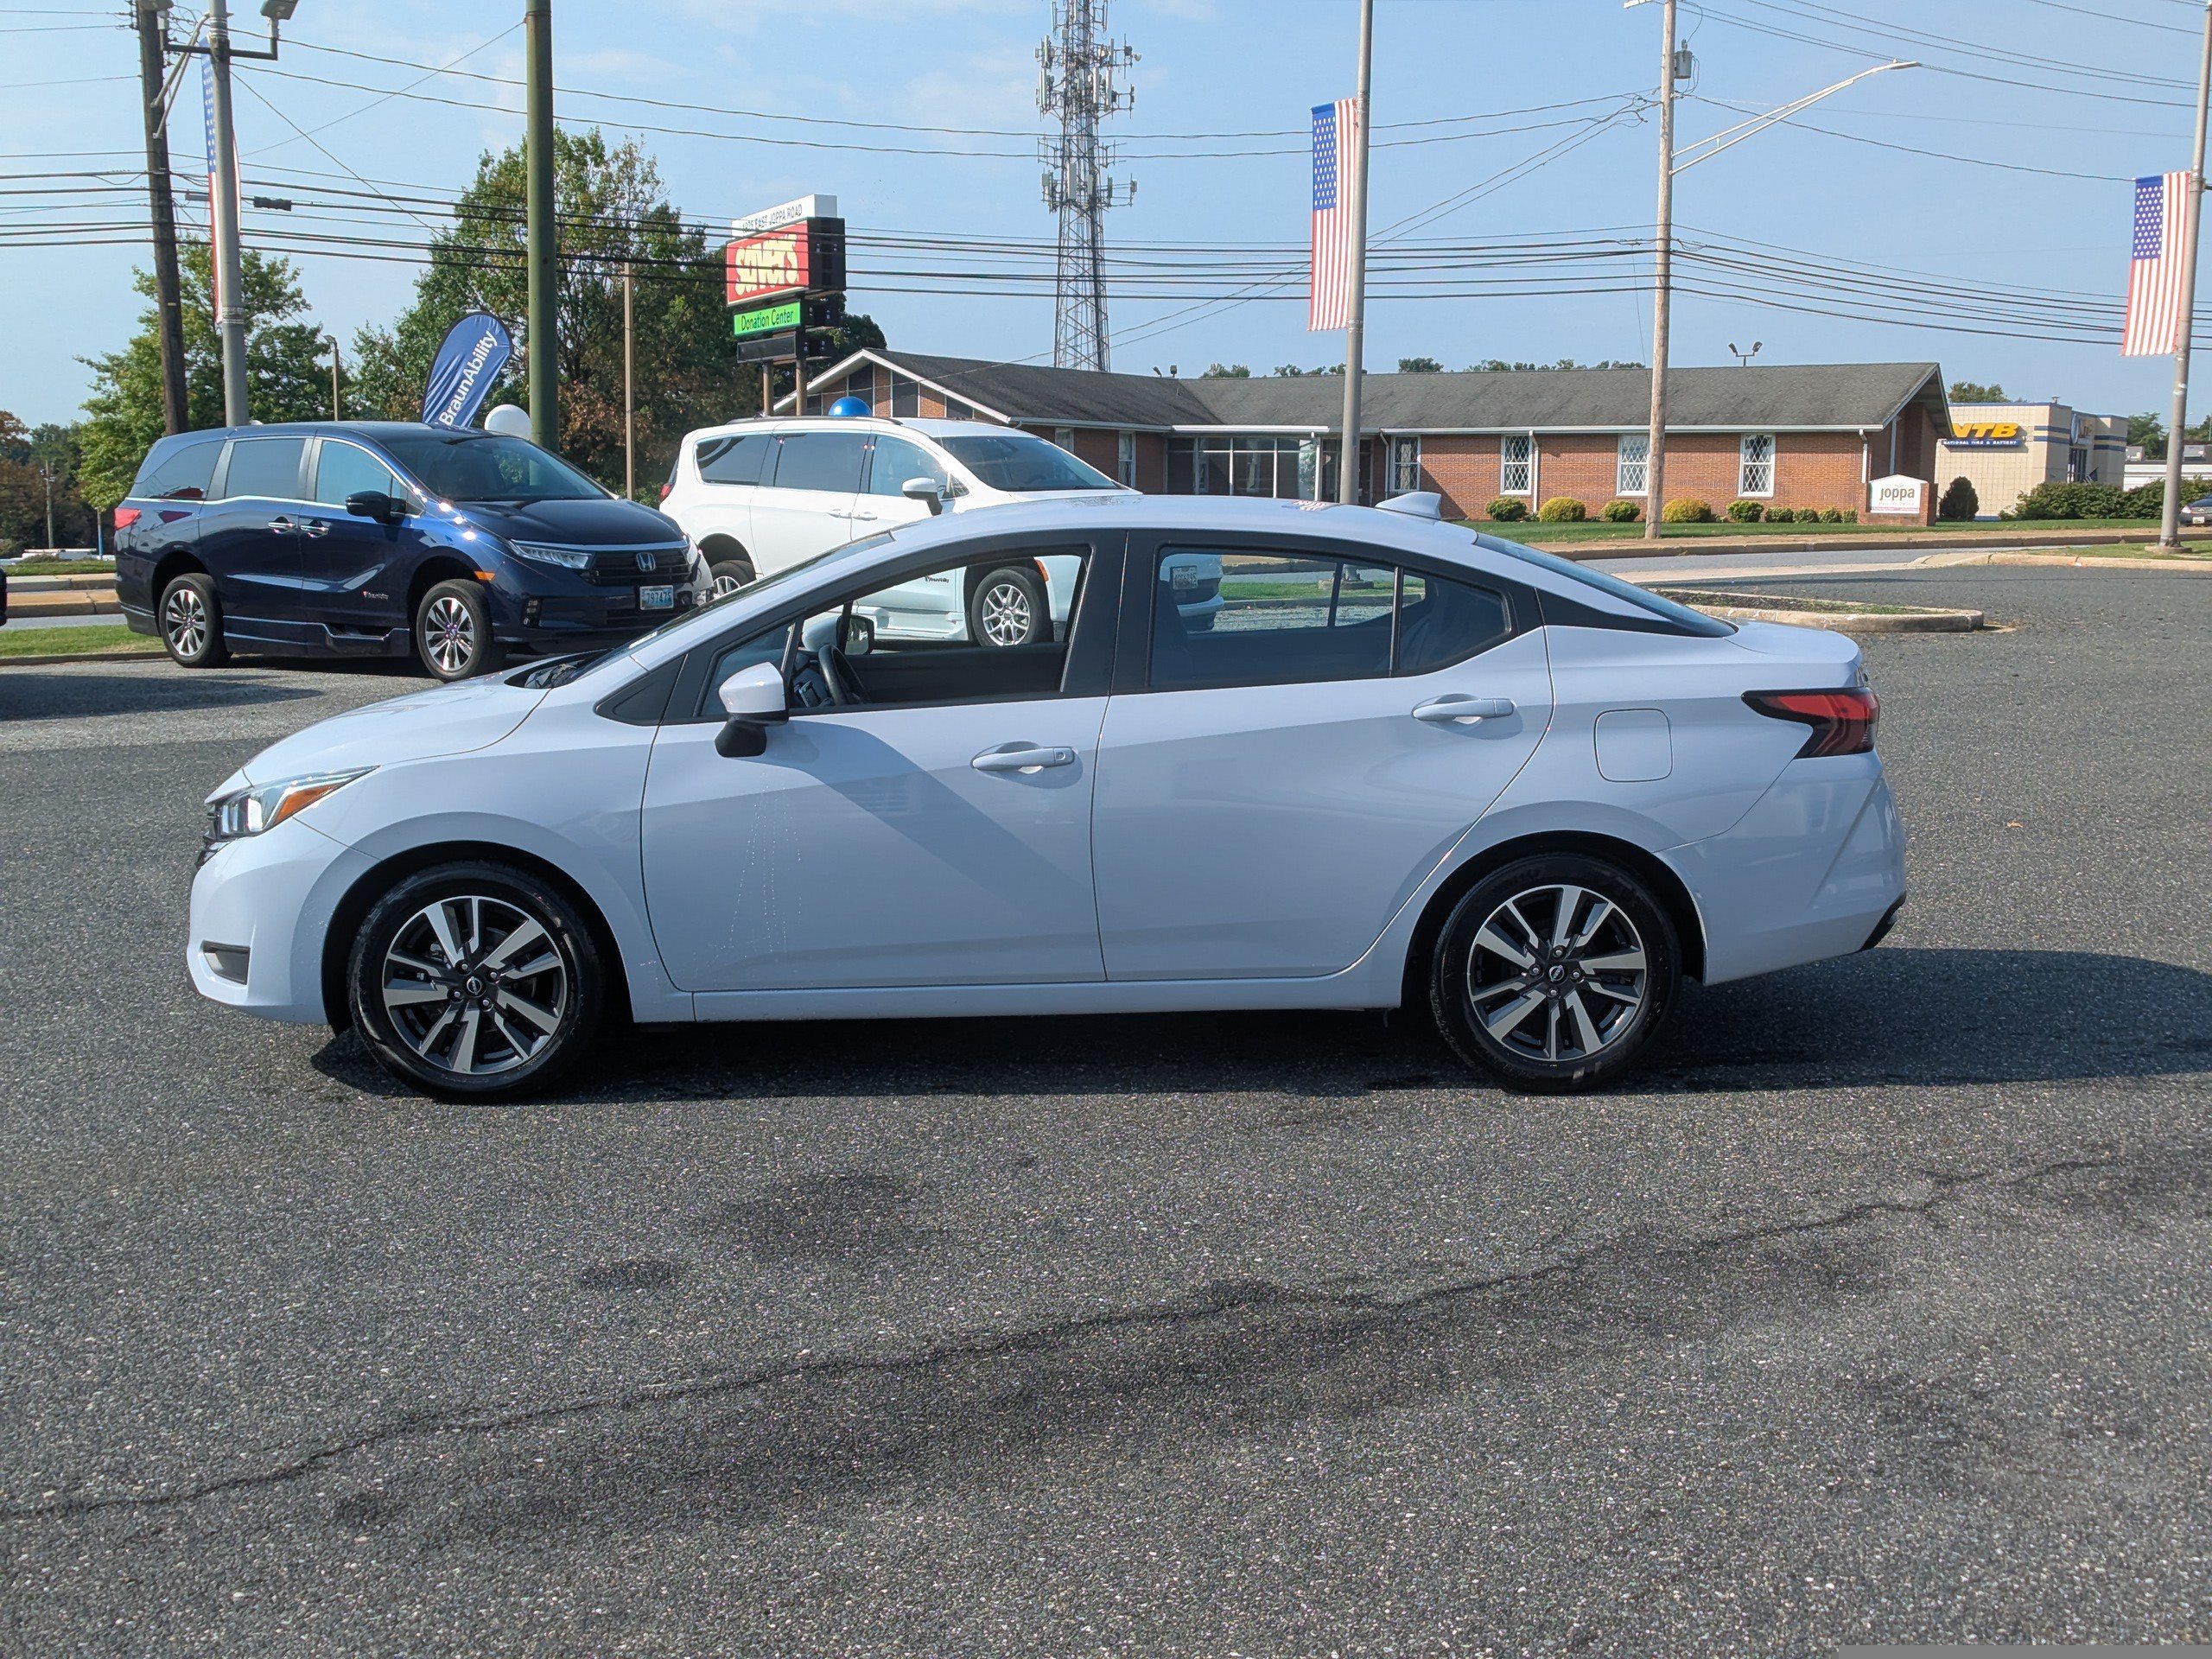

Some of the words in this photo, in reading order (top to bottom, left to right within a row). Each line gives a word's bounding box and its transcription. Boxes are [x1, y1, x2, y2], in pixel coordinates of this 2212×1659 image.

[769, 209, 786, 225] JOPPA
[787, 204, 803, 219] ROAD
[741, 312, 769, 332] Donation
[771, 309, 794, 326] Center
[439, 330, 497, 426] BraunAbility
[1879, 487, 1915, 500] joppa
